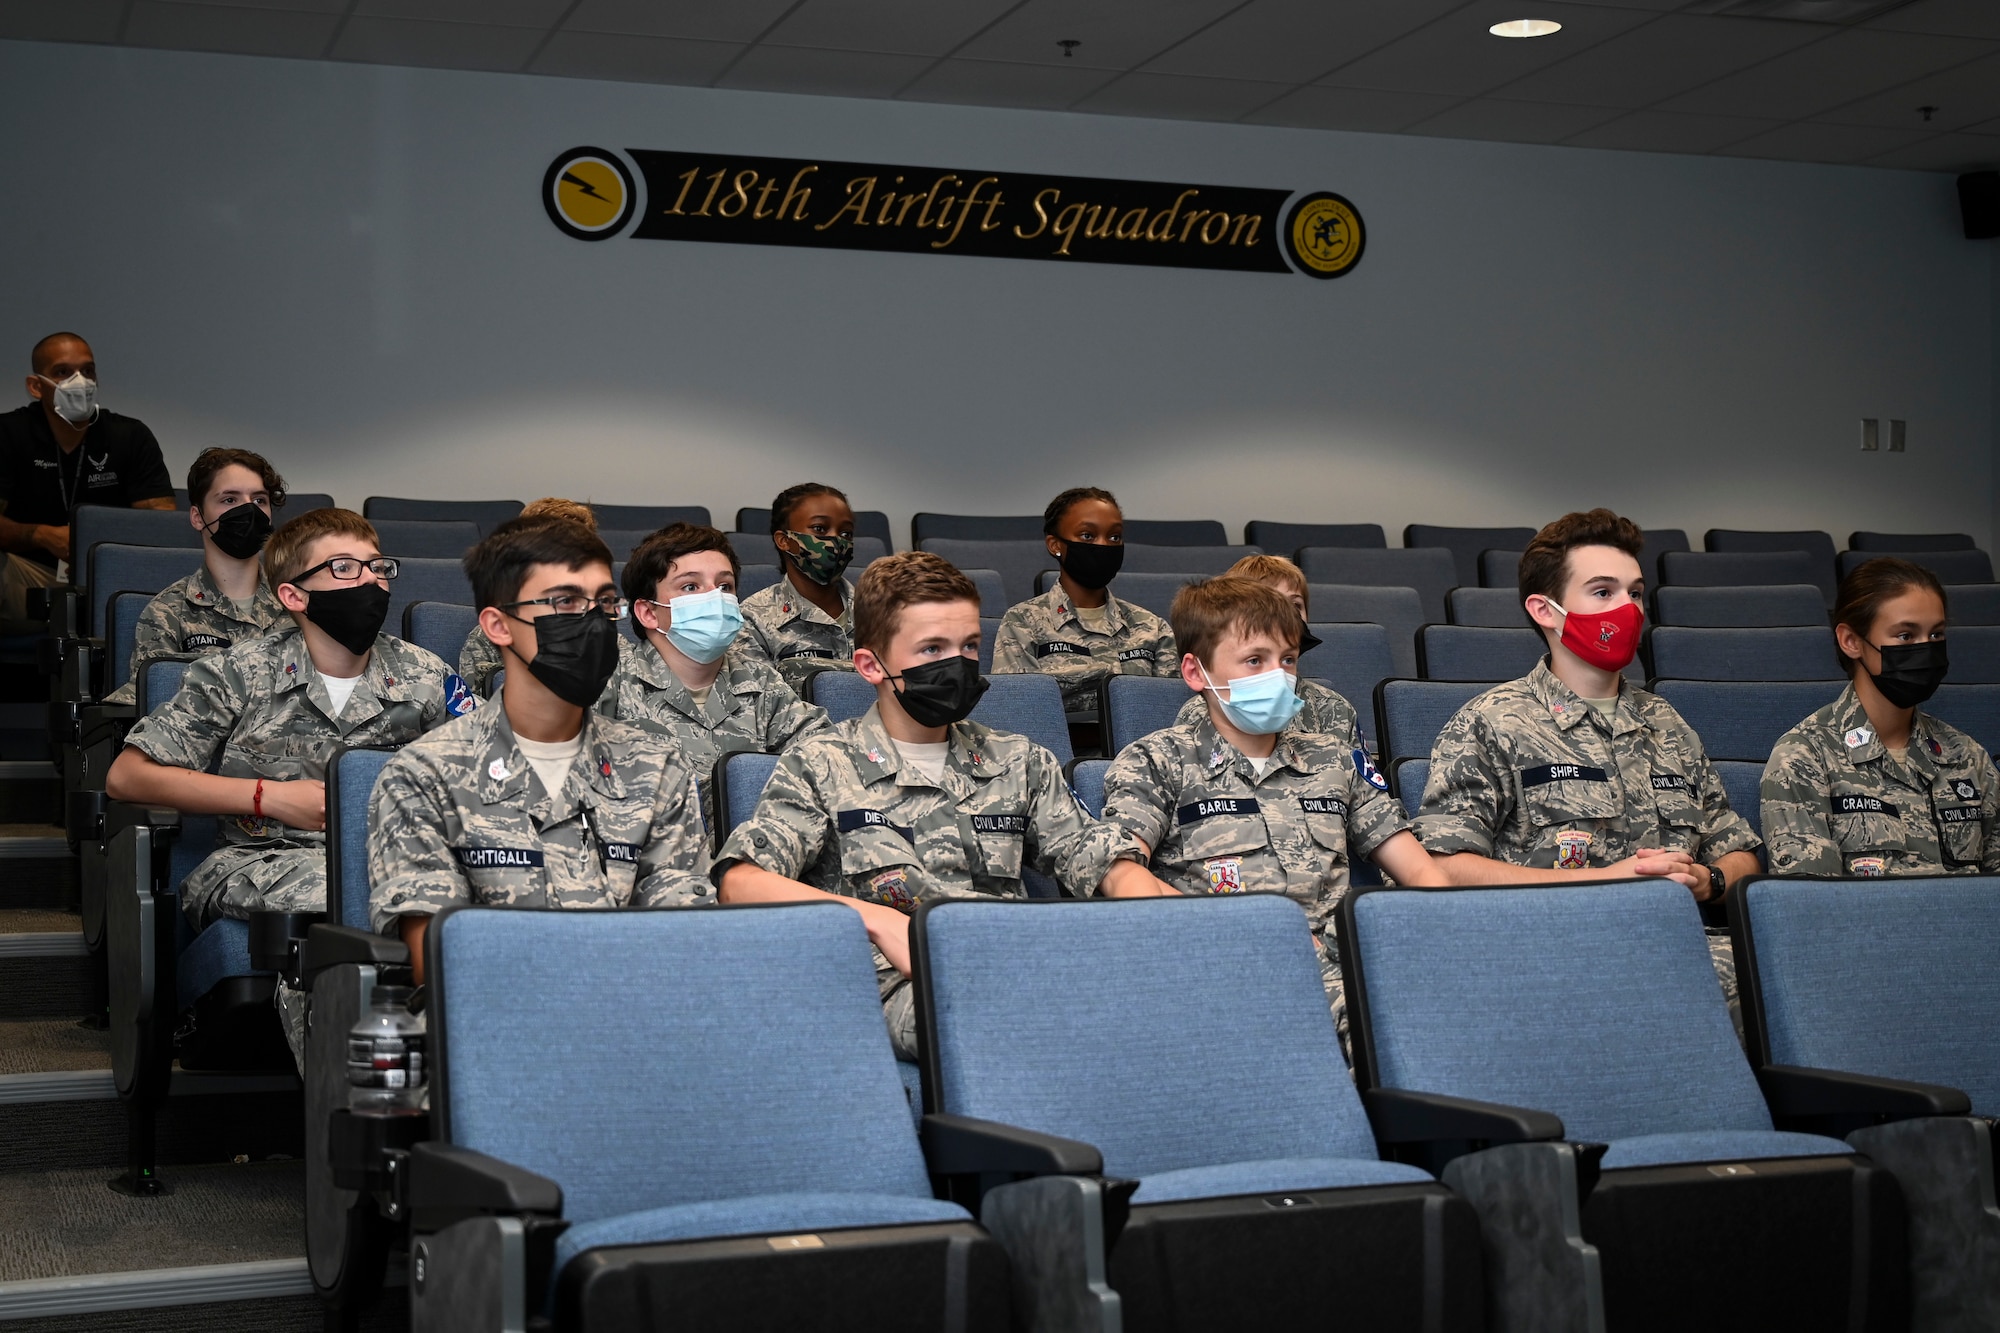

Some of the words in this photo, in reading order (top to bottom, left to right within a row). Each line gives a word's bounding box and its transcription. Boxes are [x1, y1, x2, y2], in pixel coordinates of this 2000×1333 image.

[664, 166, 818, 221] 118th
[815, 176, 1005, 248] Airlift
[1013, 188, 1262, 255] Squadron
[187, 635, 218, 648] BRYANT
[1049, 643, 1074, 653] FATAL
[1550, 766, 1580, 778] SHIPE
[1652, 777, 1673, 788] CIVIL
[1199, 800, 1238, 815] BARILE
[1303, 800, 1327, 811] CIVIL
[1327, 800, 1340, 813] AIR
[1842, 798, 1882, 811] CRAMER
[864, 811, 893, 828] DIETZ
[1944, 809, 1965, 821] CIVIL
[1966, 807, 1978, 819] AIR
[974, 816, 997, 830] CIVIL
[998, 816, 1011, 830] AIR
[609, 845, 634, 860] CIVIL
